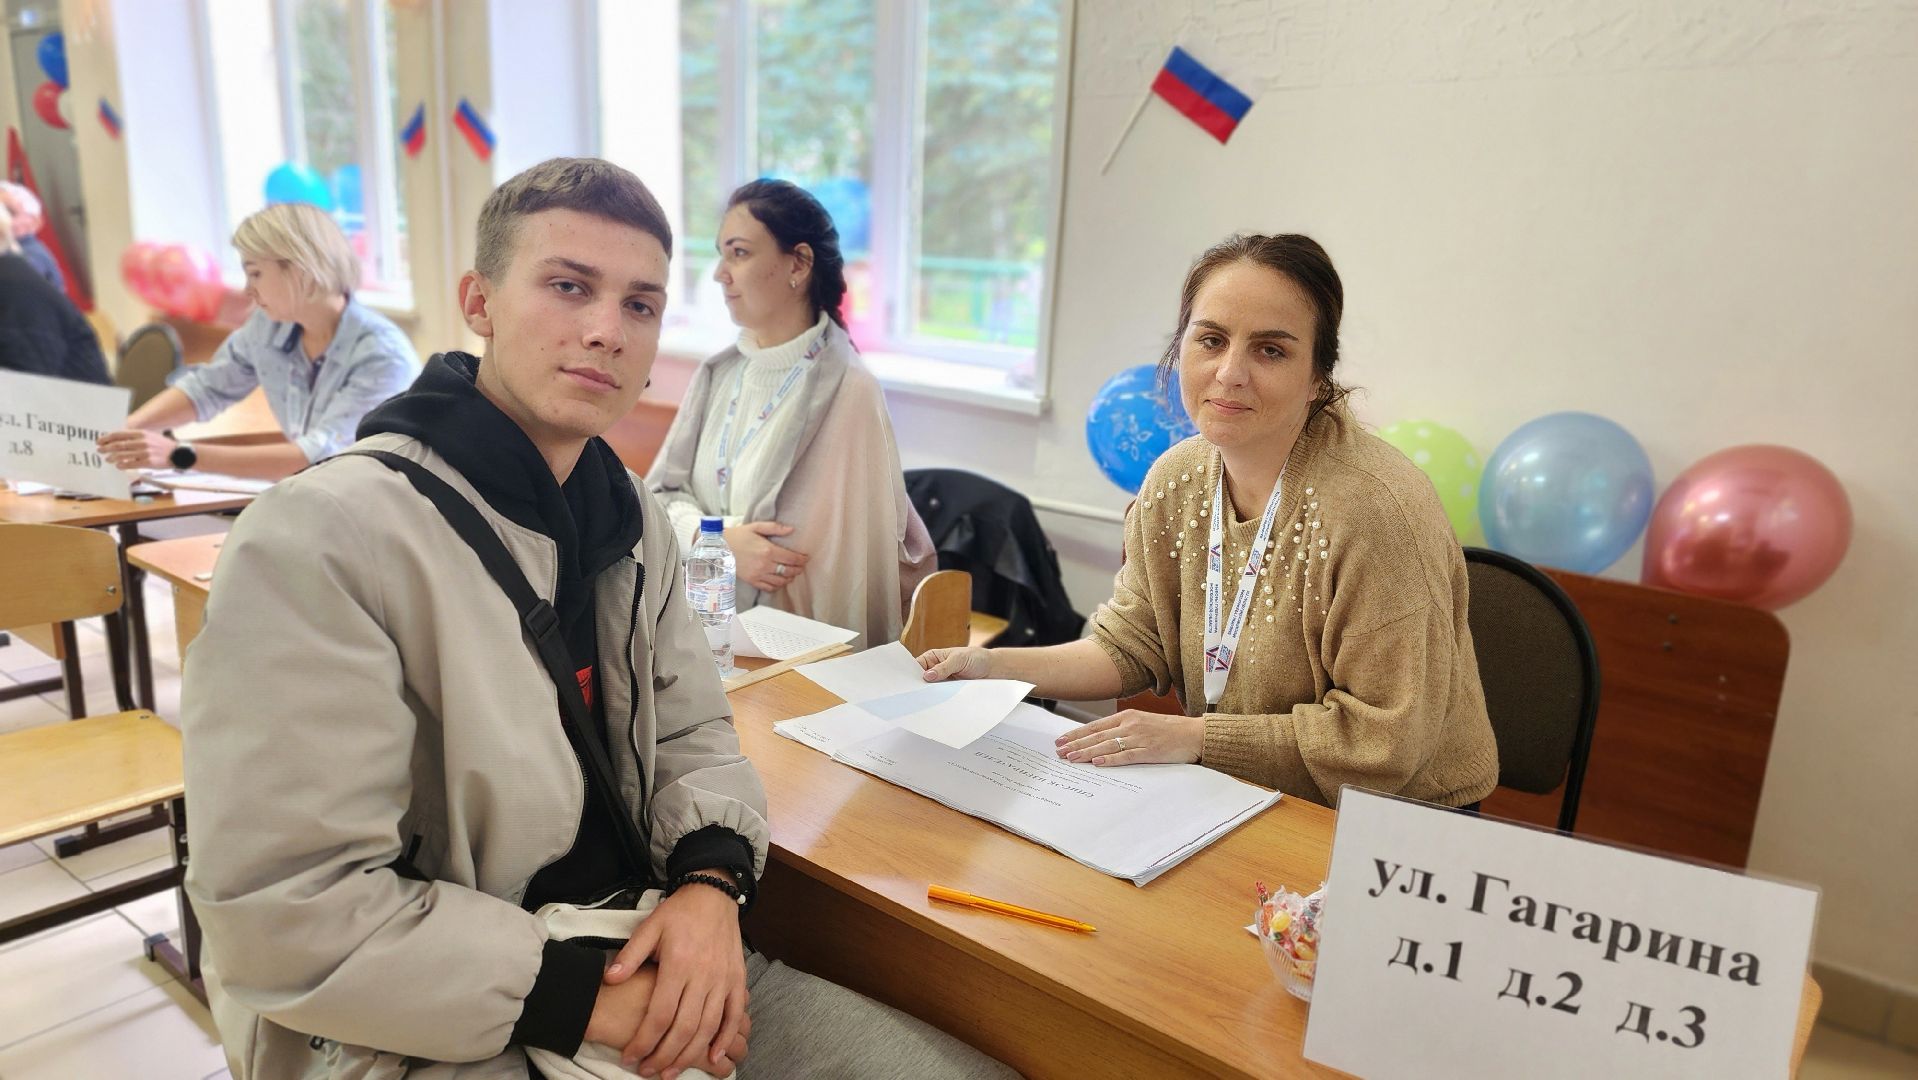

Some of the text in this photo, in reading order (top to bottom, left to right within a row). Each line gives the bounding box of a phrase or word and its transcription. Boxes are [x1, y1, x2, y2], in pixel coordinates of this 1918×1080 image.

[9, 440, 102, 469] д.8 д.10
[1368, 858, 1761, 986] ул. Гагарина
[1388, 936, 1706, 1048] д.1 д.2 д.3
